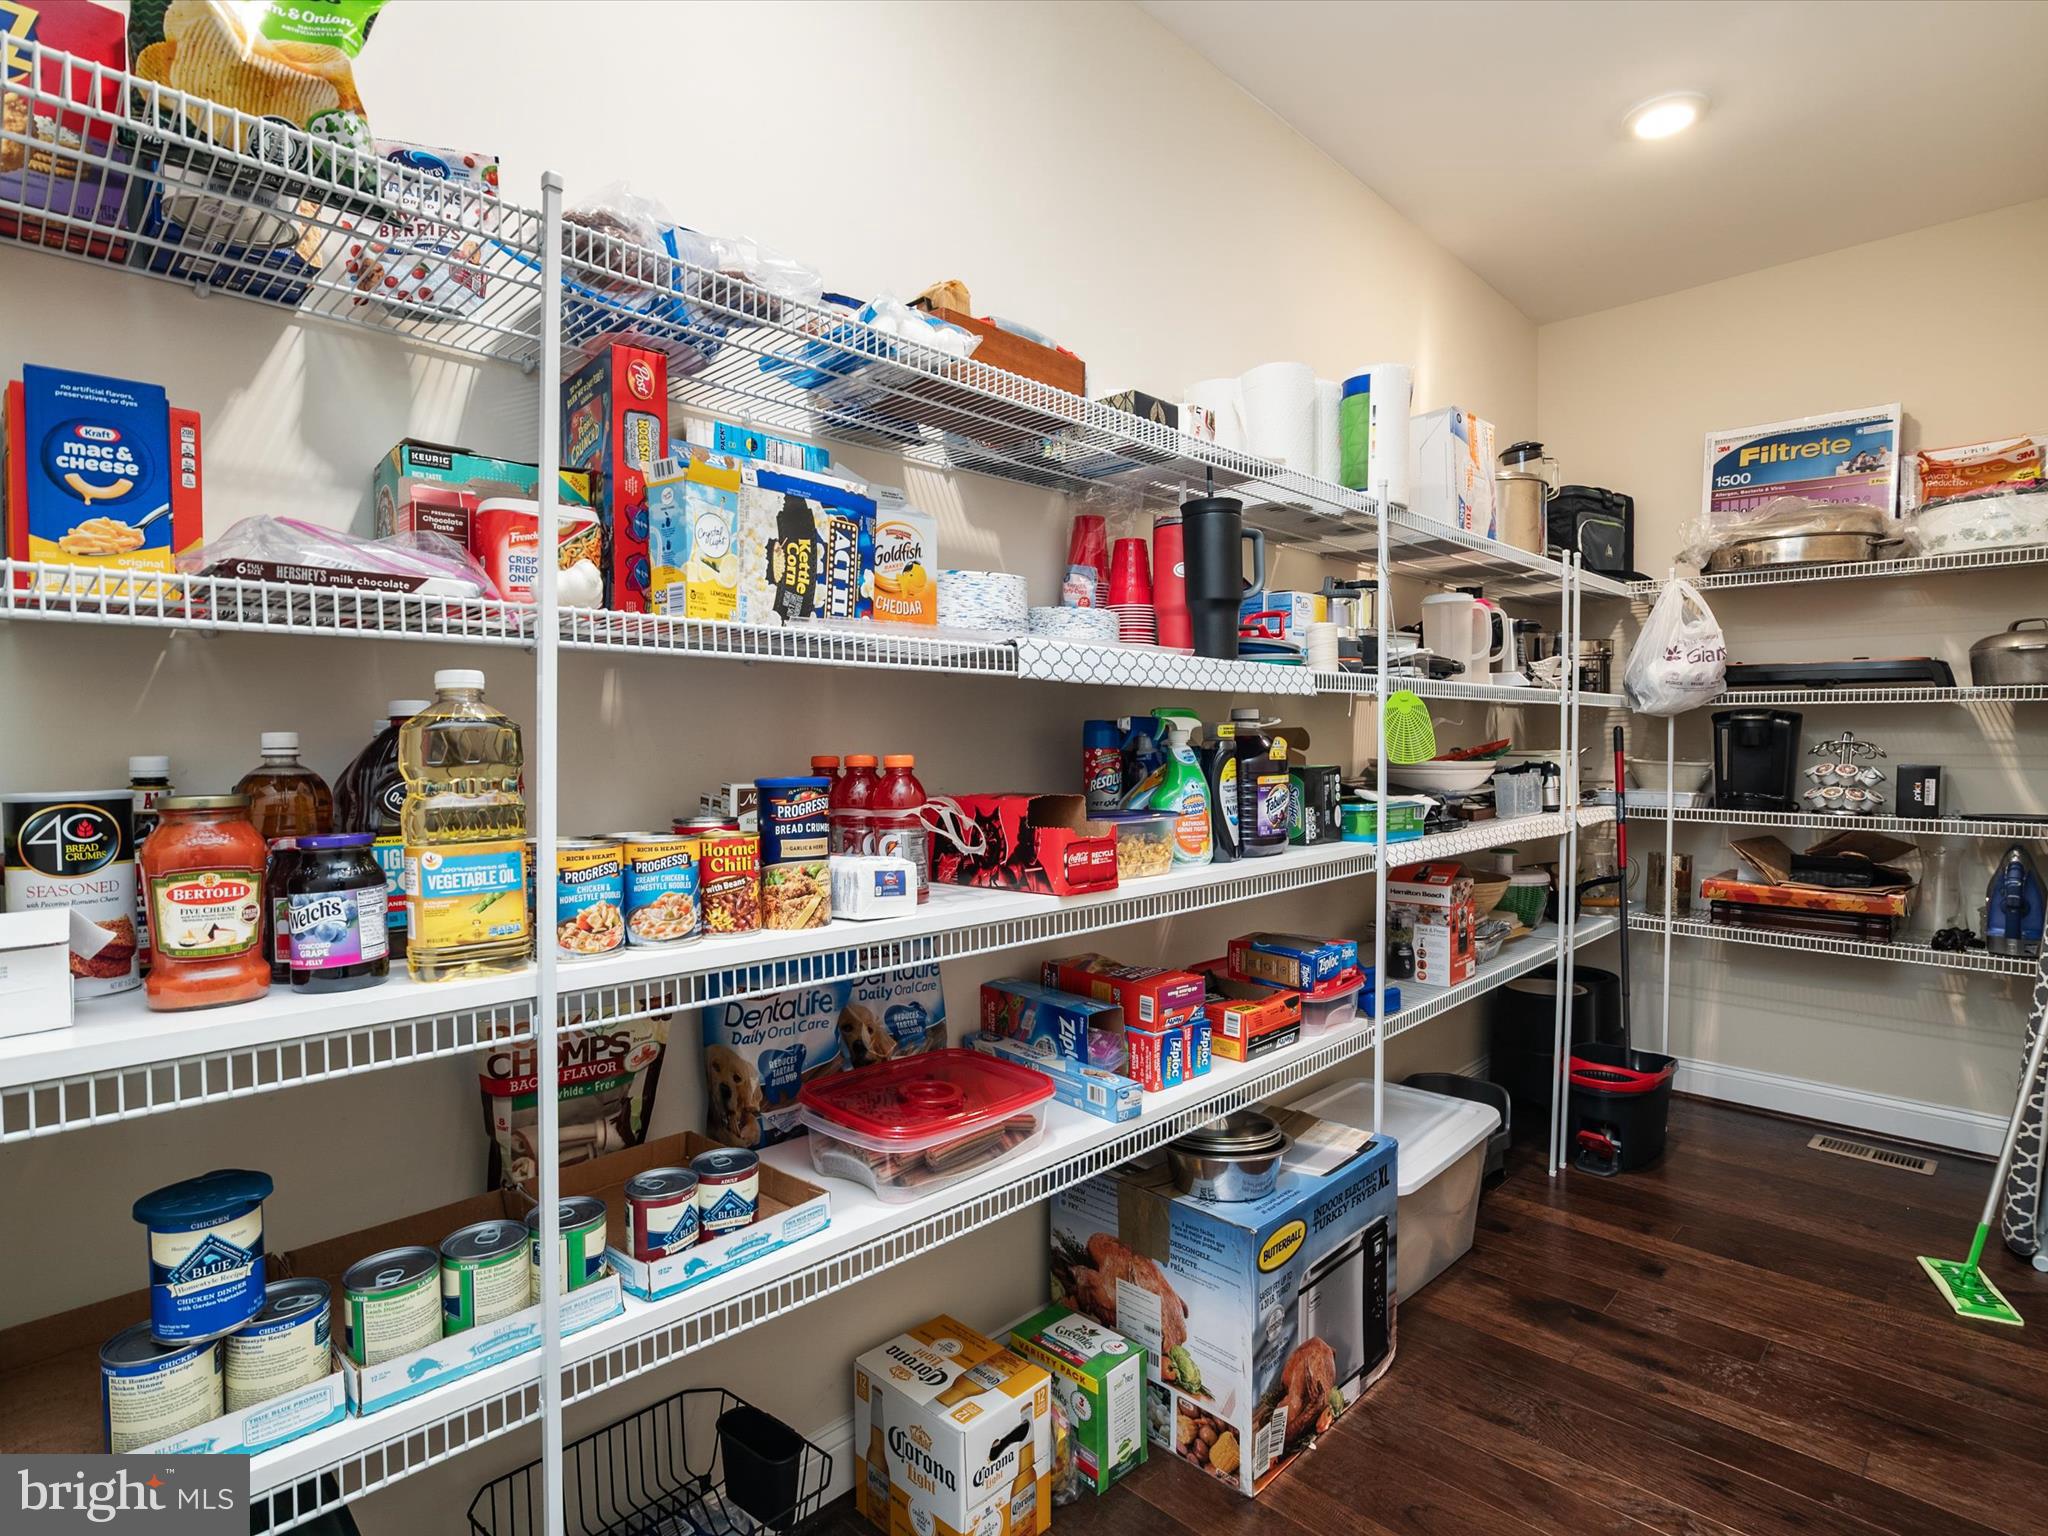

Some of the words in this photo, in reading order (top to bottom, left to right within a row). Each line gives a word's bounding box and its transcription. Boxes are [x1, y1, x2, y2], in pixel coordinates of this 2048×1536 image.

[302, 10, 355, 27] Onion
[631, 363, 650, 395] Post
[54, 389, 110, 404] preservatives,
[120, 398, 139, 408] dyes
[72, 384, 105, 396] artificial
[105, 390, 134, 400] flavors,
[84, 428, 112, 440] Kraft
[63, 441, 114, 458] mac
[116, 446, 134, 462] &
[1717, 445, 1731, 453] 3M
[1738, 437, 1852, 468] Filtrete
[2016, 449, 2035, 461] 3M
[411, 452, 451, 465] KEURIG
[1715, 472, 1752, 487] 1500
[422, 515, 464, 527] Chocolate
[432, 522, 455, 532] Taste
[833, 530, 851, 584] ACT
[874, 541, 923, 567] Goldfish
[118, 557, 165, 570] original
[236, 562, 247, 575] 6
[509, 565, 538, 574] FRIED
[785, 541, 800, 587] Corn
[796, 538, 812, 595] Kettle
[276, 565, 327, 583] HERSHEY'S
[329, 574, 354, 585] milk
[356, 576, 410, 590] chocolate
[710, 590, 737, 598] LEMONADE
[875, 595, 923, 615] CHEDDAR
[775, 823, 803, 836] BREAD
[805, 822, 830, 833] CRUMBS
[26, 813, 104, 872] 4C
[65, 843, 99, 853] BREAD
[701, 839, 758, 857] Hormel
[65, 850, 108, 862] CRUMBS
[1091, 850, 1115, 859] RECYCLE
[635, 853, 689, 874] PROGRESSO
[710, 857, 752, 873] Chili
[427, 870, 497, 890] VEGETABLE
[499, 868, 518, 883] OIL
[564, 861, 618, 884] PROGRESSO
[635, 875, 660, 885] CREAMY
[660, 873, 685, 883] CHICKEN
[26, 879, 120, 899] SEASONED
[172, 885, 246, 901] BERTOLLI
[576, 884, 606, 894] CHICKEN
[633, 882, 667, 893] HOMESTYLE
[668, 881, 692, 890] NOODLES
[706, 882, 723, 894] with
[723, 878, 746, 890] Beans
[1389, 888, 1421, 897] Hamilton
[1421, 891, 1445, 899] Beach
[26, 900, 40, 909] with
[559, 893, 599, 904] HOMESTYLE
[180, 907, 200, 916] FIVE
[202, 905, 237, 914] CHEESE
[289, 900, 342, 930] Welch's
[300, 949, 330, 958] GRAPE
[1341, 946, 1355, 960] Ziploc
[305, 959, 324, 967] JELLY
[1317, 953, 1340, 974] Ziploc
[1301, 964, 1311, 988] Ziploc
[858, 986, 893, 1001] Daily
[894, 984, 915, 995] Oral
[915, 981, 937, 993] Care
[731, 1029, 767, 1046] Daily
[767, 1023, 796, 1040] Oral
[797, 1018, 830, 1033] Care
[1200, 1030, 1211, 1066] Ziploc
[768, 1055, 798, 1070] REDUCES
[1169, 1040, 1182, 1078] Ziploc
[563, 1061, 617, 1082] FLAVOR
[772, 1064, 795, 1078] TARTAR
[594, 1079, 616, 1093] Free
[771, 1072, 798, 1088] BUILDUP
[1118, 1110, 1129, 1121] 50
[720, 1177, 739, 1185] ADULT
[1313, 1194, 1343, 1222] INDOOR
[1344, 1170, 1379, 1198] ELECTRIC
[1378, 1163, 1390, 1192] XL
[718, 1207, 742, 1220] BLUE
[1312, 1203, 1351, 1235] TURKEY
[1351, 1184, 1379, 1209] FRYER
[190, 1214, 231, 1230] CHICKEN
[1169, 1239, 1211, 1262] DESCONGELE
[1263, 1227, 1303, 1263] BUTTERBALL
[192, 1259, 232, 1279] BLUE
[459, 1263, 480, 1271] LAMB
[1169, 1253, 1198, 1270] INYECTE
[177, 1275, 220, 1295] Homestyle
[220, 1270, 246, 1283] Recipe
[176, 1293, 215, 1306] CHICKEN
[217, 1280, 247, 1298] DINNER
[177, 1304, 192, 1312] with
[192, 1299, 217, 1310] Garden
[217, 1288, 247, 1304] Vegetables
[258, 1320, 297, 1336] CHICKEN
[1054, 1325, 1096, 1351] Greenies
[158, 1350, 199, 1372] CHICKEN
[885, 1344, 949, 1386] Corona
[1018, 1341, 1057, 1369] VARIETY
[1060, 1363, 1088, 1386] PACK
[857, 1372, 867, 1386] 12
[1036, 1386, 1046, 1402] 12
[1079, 1396, 1086, 1407] 3
[887, 1425, 957, 1492] Corona
[972, 1449, 1015, 1488] Corona
[906, 1466, 937, 1495] Light
[984, 1471, 1004, 1490] Light
